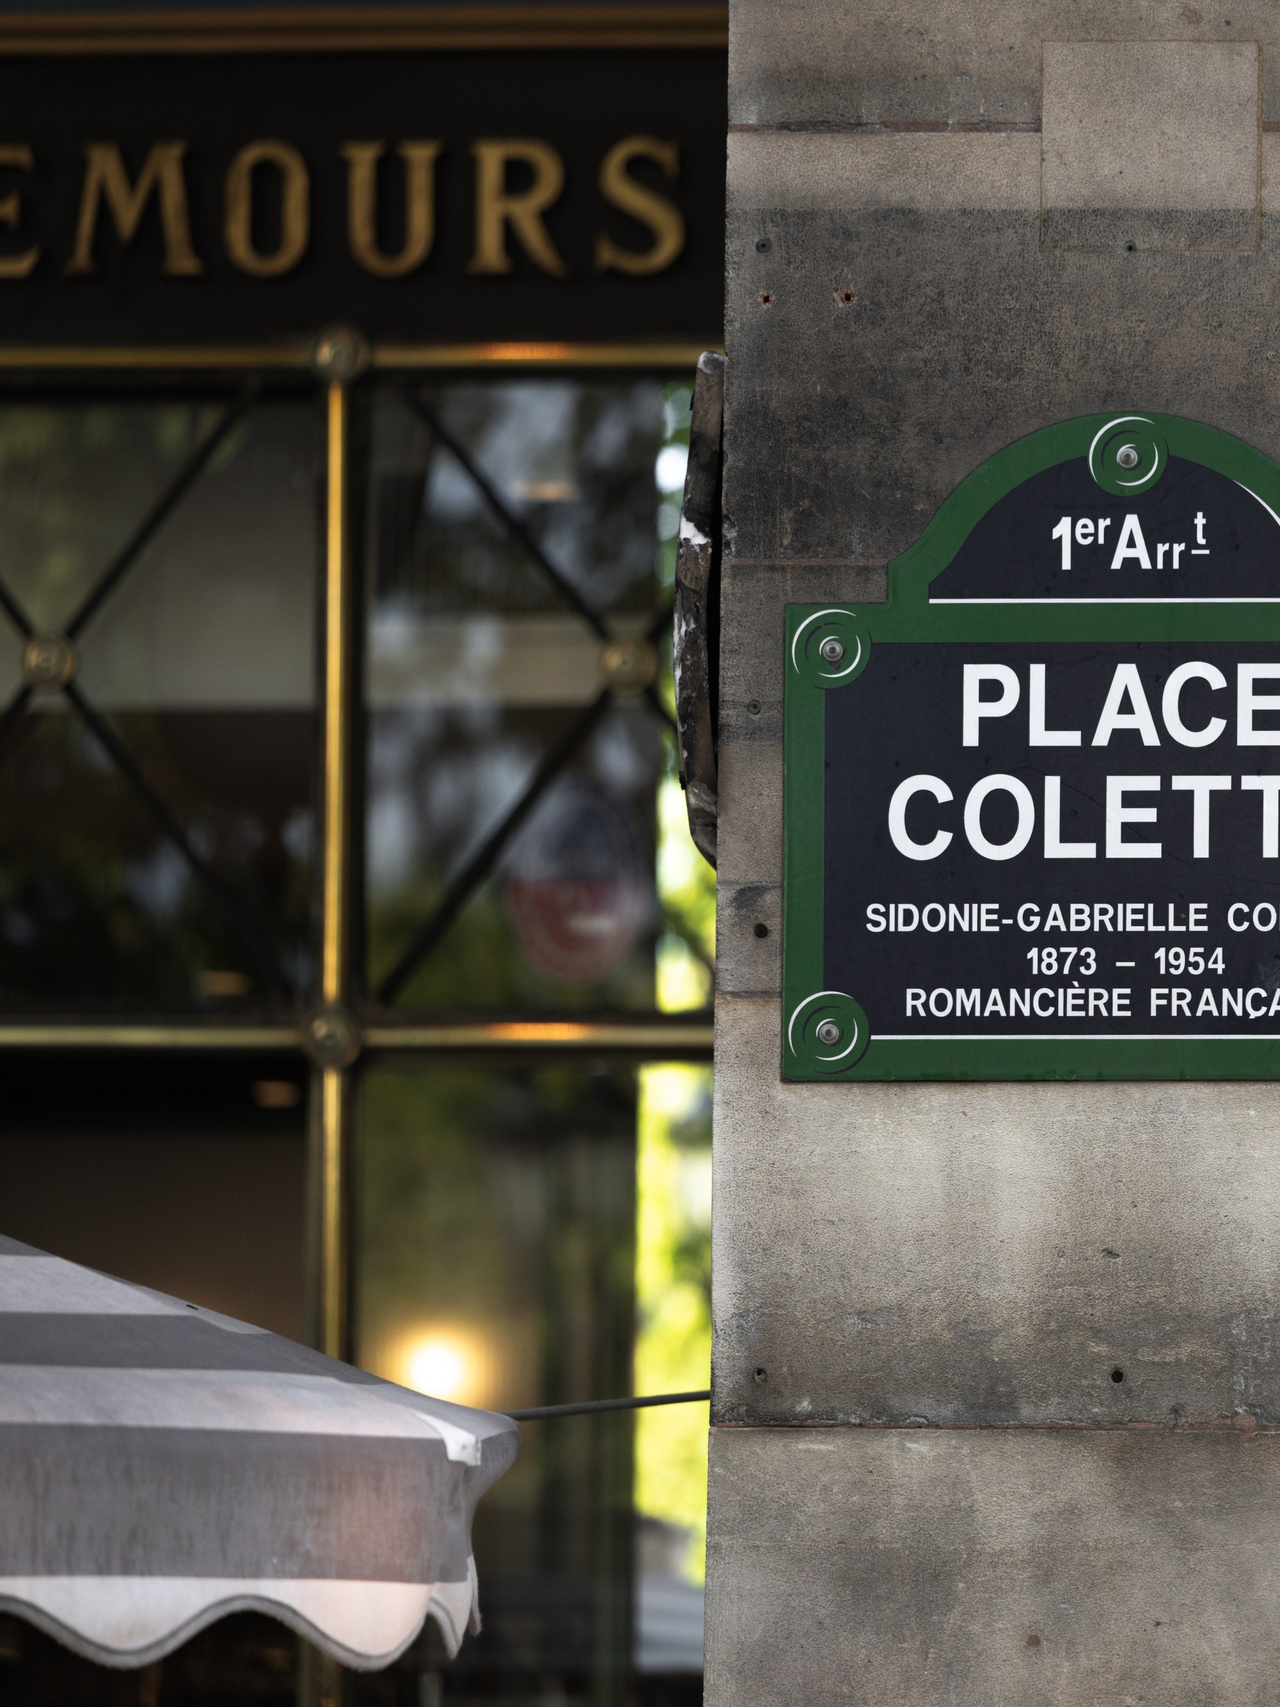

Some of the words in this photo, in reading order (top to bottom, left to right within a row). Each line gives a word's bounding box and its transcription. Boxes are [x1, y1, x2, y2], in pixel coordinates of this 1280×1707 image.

[865, 902, 1209, 932] SIDONIE-GABRIELLE
[1026, 946, 1097, 976] 1873
[1154, 946, 1226, 976] 1954
[905, 981, 1132, 1018] ROMANCIÈRE
